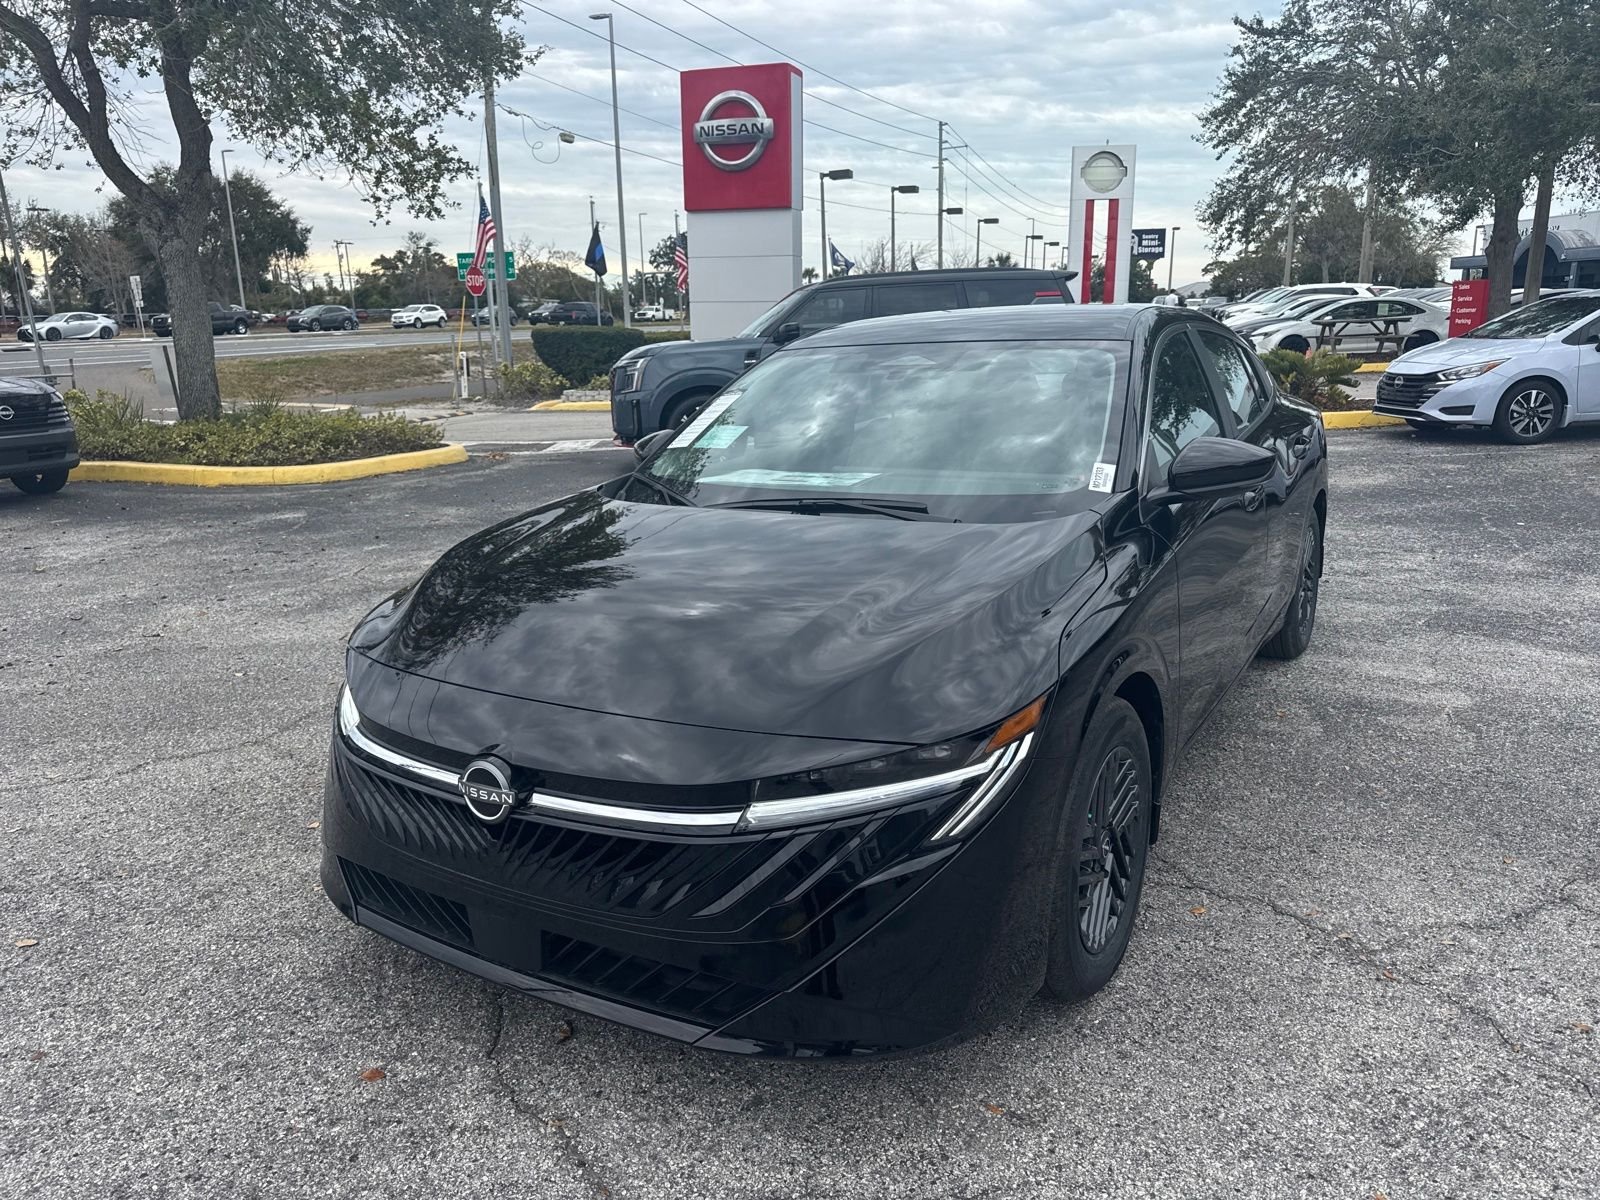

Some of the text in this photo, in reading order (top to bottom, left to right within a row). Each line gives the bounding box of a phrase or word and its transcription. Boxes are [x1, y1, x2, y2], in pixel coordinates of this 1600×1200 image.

[700, 122, 764, 138] NISSAN
[467, 275, 484, 287] STOP
[459, 782, 513, 804] NISSAN
